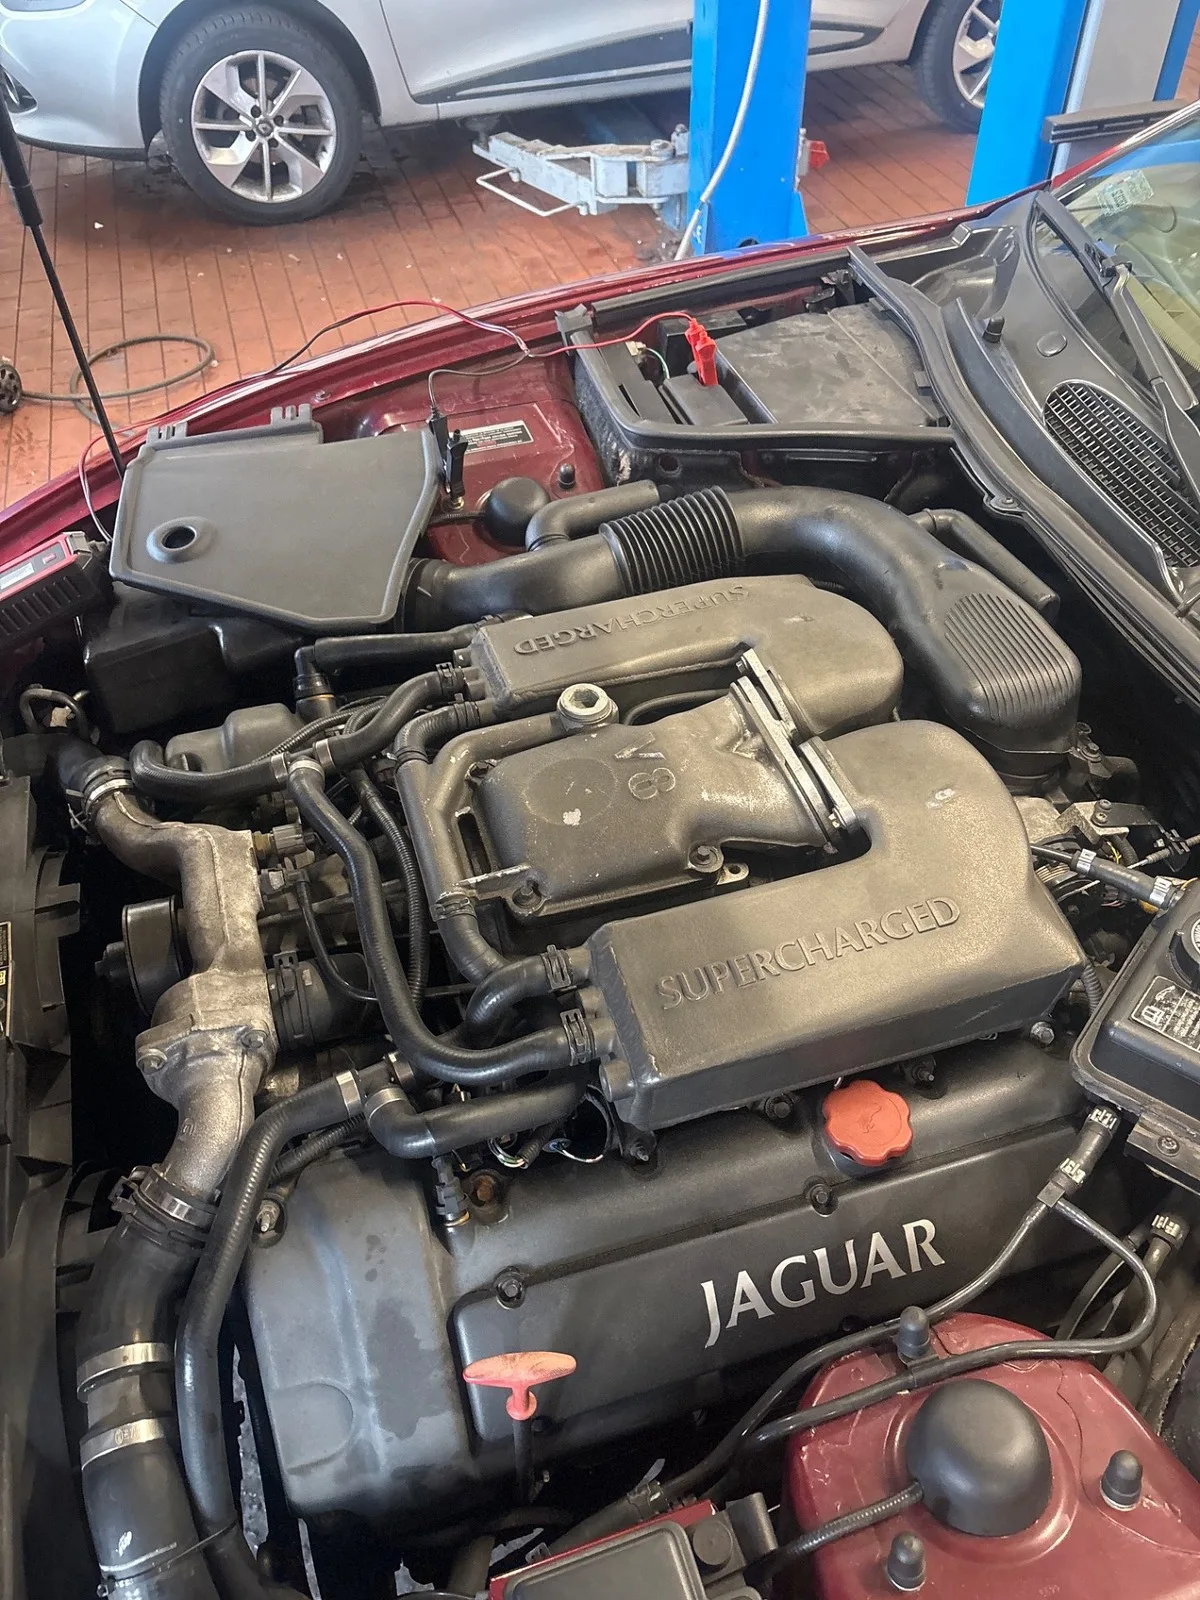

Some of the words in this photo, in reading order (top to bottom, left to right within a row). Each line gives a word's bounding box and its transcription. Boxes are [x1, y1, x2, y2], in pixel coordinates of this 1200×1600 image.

[513, 586, 749, 654] SUPERCHARGED
[656, 897, 960, 1010] SUPERCHARGED
[701, 1219, 945, 1348] JAGUAR
